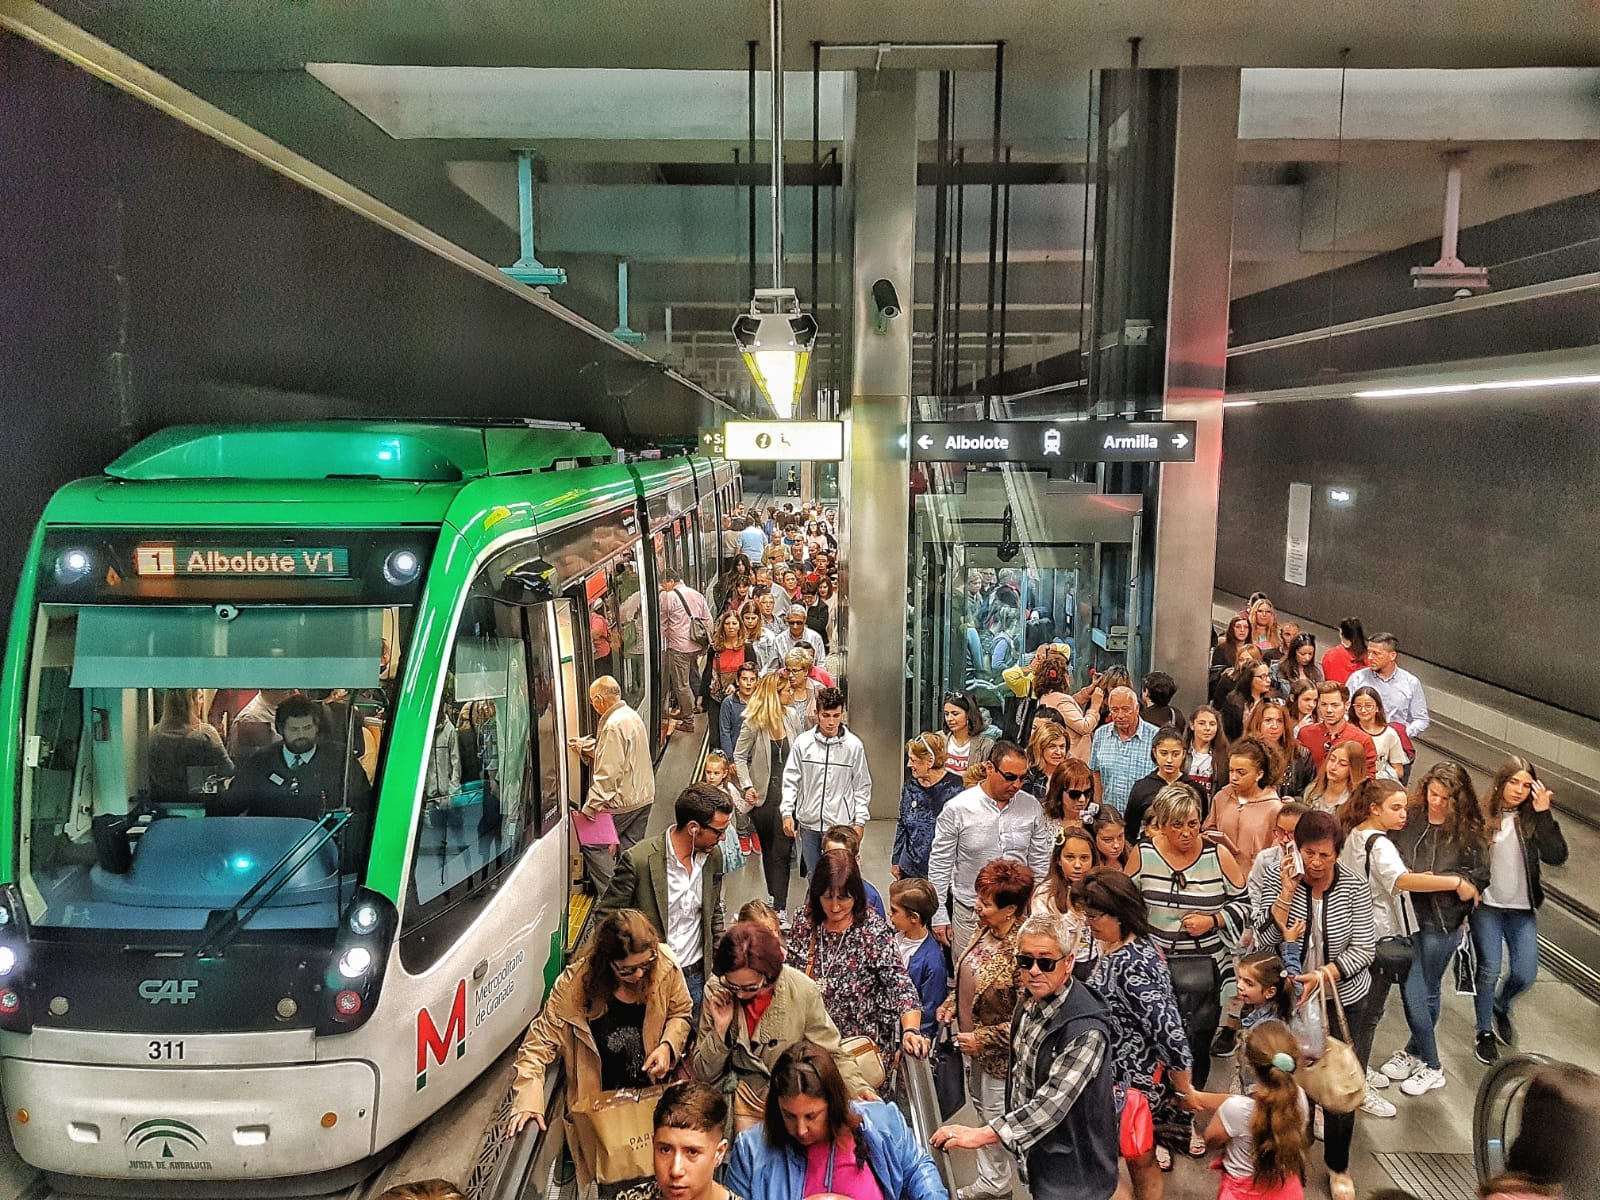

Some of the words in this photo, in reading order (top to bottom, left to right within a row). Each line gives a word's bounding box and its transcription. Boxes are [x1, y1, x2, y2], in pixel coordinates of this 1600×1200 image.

[945, 435, 1009, 450] Albolote
[1103, 435, 1158, 450] Armilla
[151, 551, 161, 571] 1
[187, 550, 296, 573] Albolote
[302, 551, 334, 573] V1
[475, 951, 525, 1007] Metropolitano
[138, 979, 199, 1005] CAF
[475, 1008, 486, 1027] de
[486, 979, 515, 1016] Granada
[148, 1041, 185, 1060] 311
[128, 1160, 154, 1169] JUNTA
[156, 1160, 167, 1169] DE
